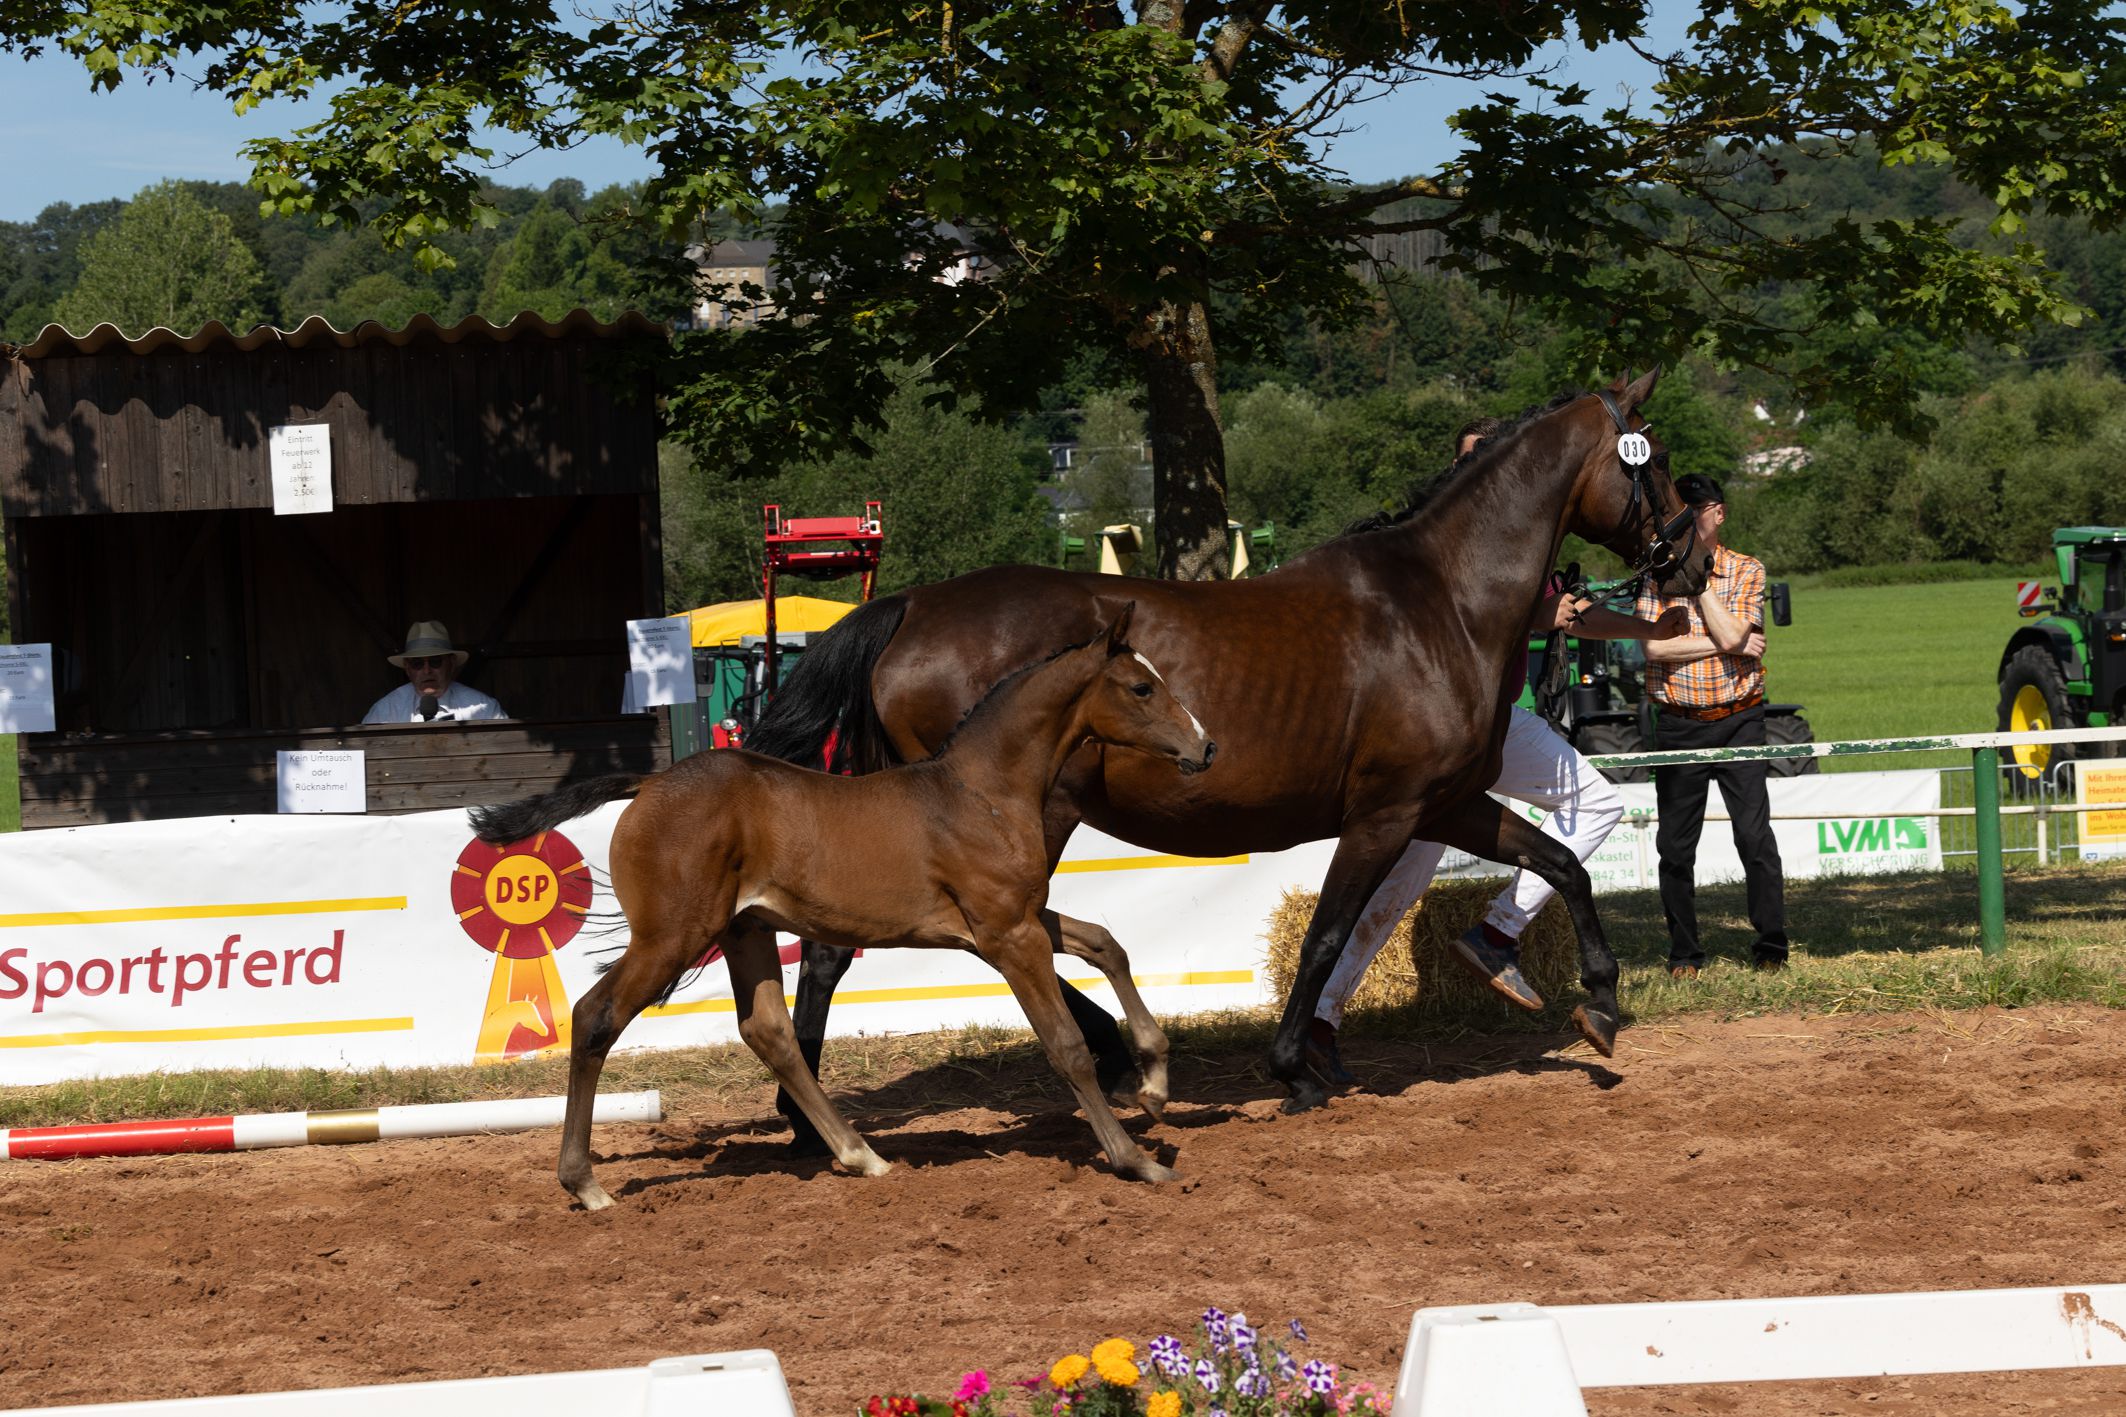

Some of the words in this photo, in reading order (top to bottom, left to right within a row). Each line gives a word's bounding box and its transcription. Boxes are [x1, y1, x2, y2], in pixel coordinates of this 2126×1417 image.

[288, 436, 312, 444] Eintritt
[282, 448, 320, 457] Feuerwerk
[1623, 440, 1646, 458] 030
[292, 461, 302, 469] ab
[311, 754, 352, 762] Umtausch
[311, 768, 332, 777] oder
[1818, 818, 1891, 855] LVM
[496, 874, 549, 904] DSP
[0, 929, 345, 1014] Sportpferd
